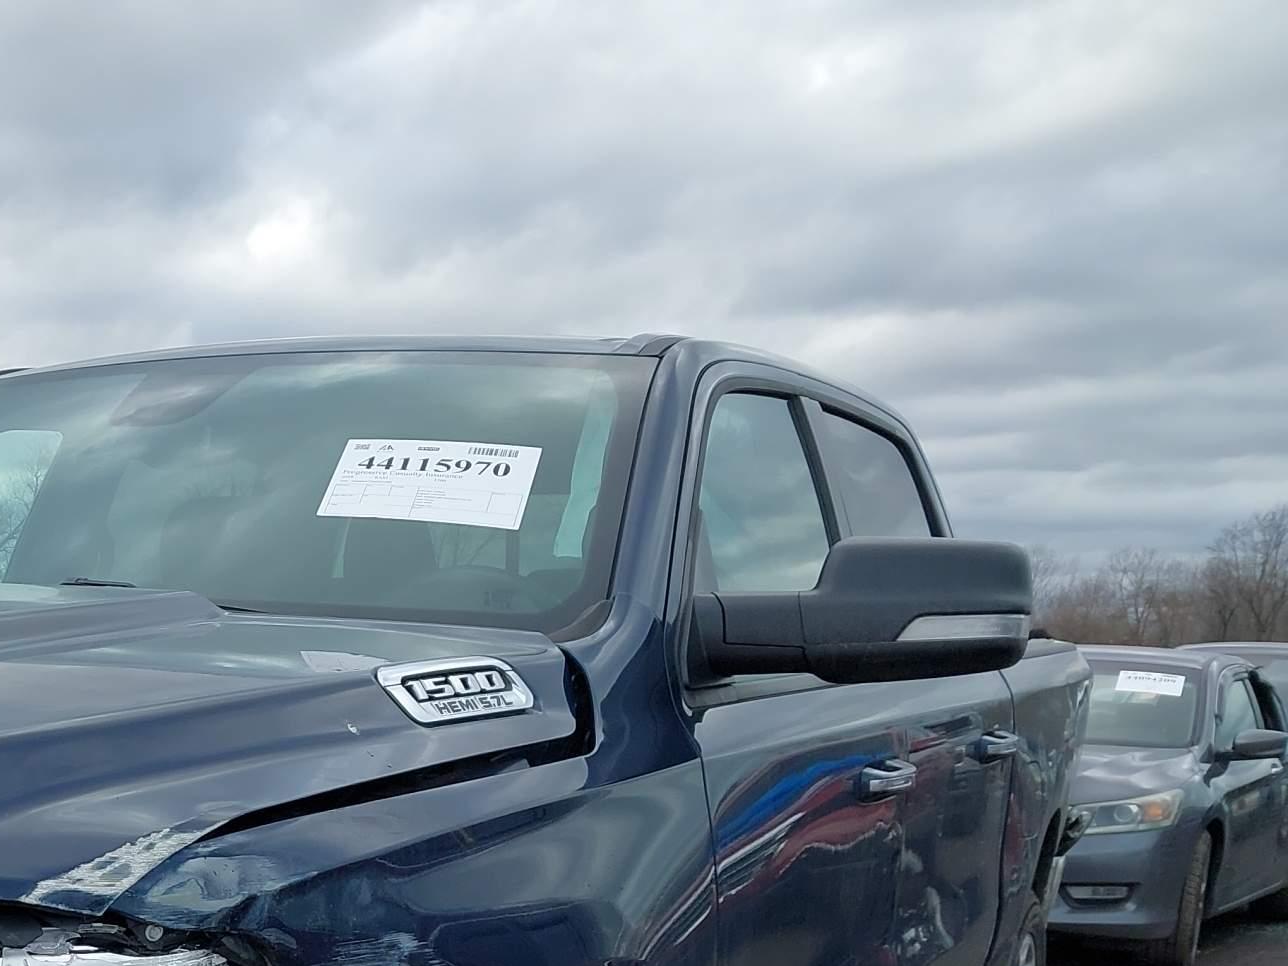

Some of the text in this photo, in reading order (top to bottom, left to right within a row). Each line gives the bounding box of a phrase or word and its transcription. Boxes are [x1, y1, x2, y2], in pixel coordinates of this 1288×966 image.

[357, 456, 511, 477] 44115970
[404, 671, 506, 700] 1500
[436, 694, 513, 715] HEMI 5.7L
